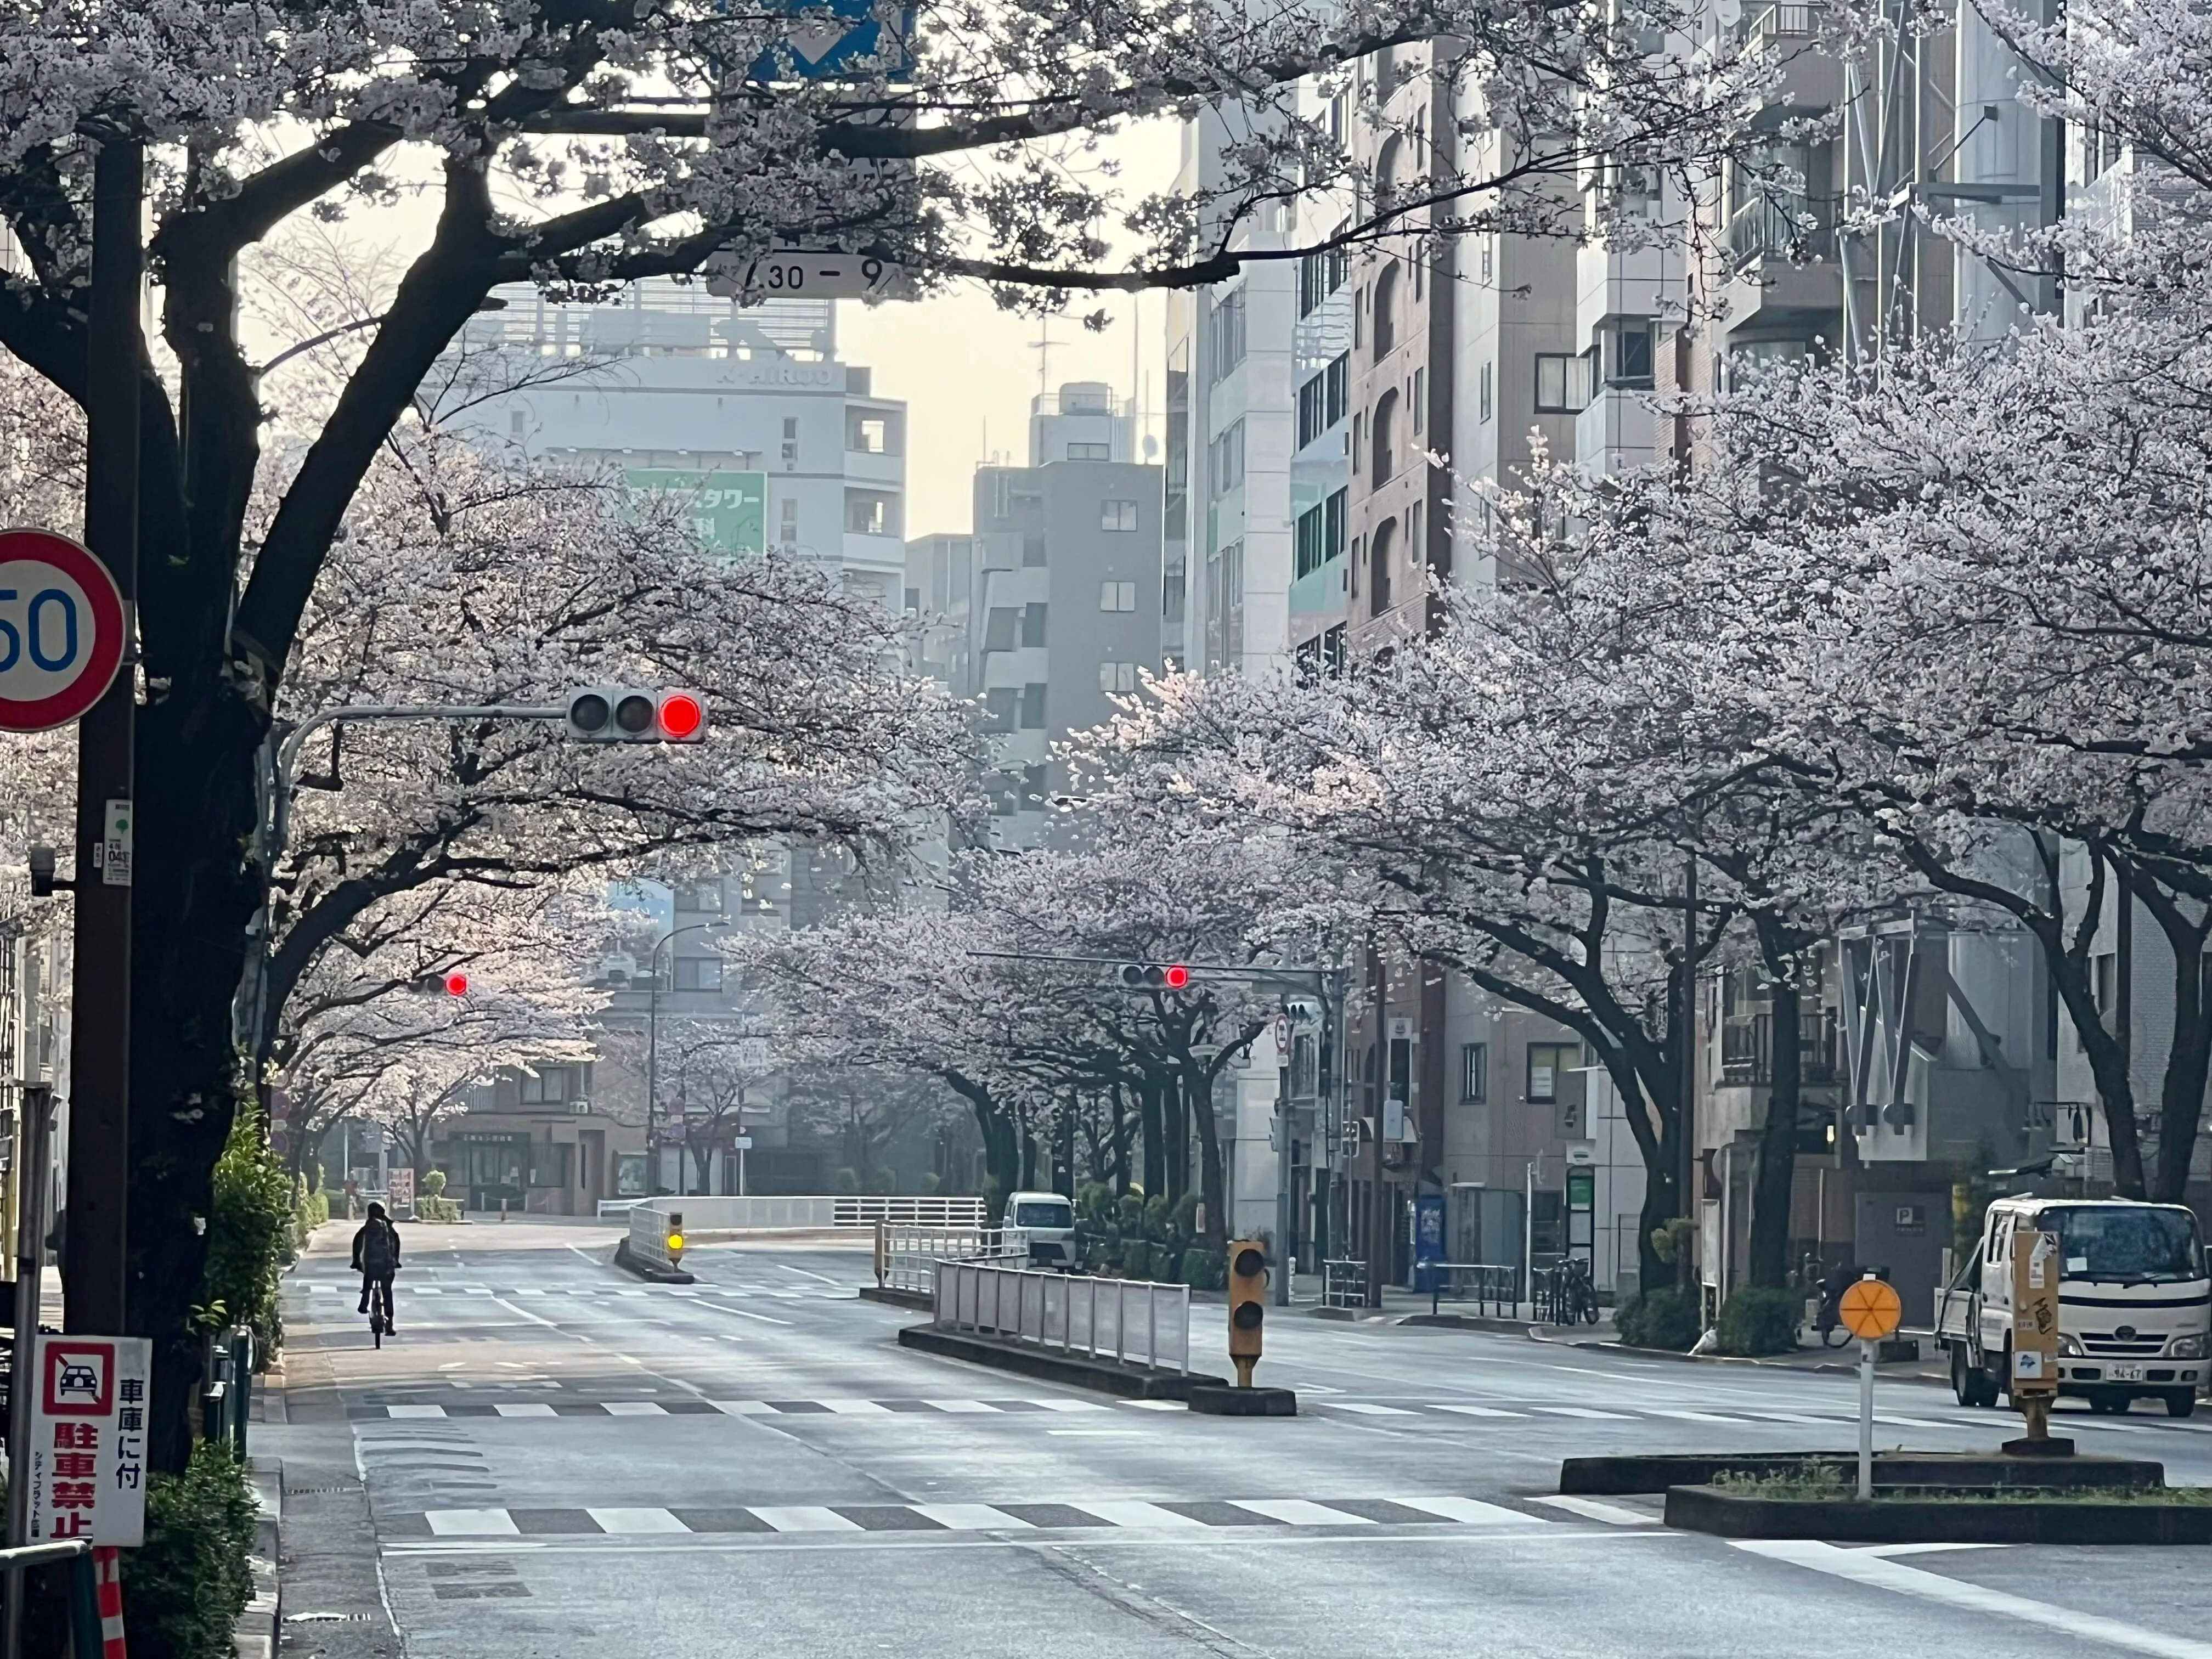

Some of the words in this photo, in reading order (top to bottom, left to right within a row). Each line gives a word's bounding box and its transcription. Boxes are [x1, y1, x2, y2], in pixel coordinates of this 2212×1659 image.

[861, 259, 883, 290] 9
[0, 589, 78, 673] 50
[50, 1422, 99, 1539] 駐車禁止
[116, 1378, 144, 1489] 車庫に付
